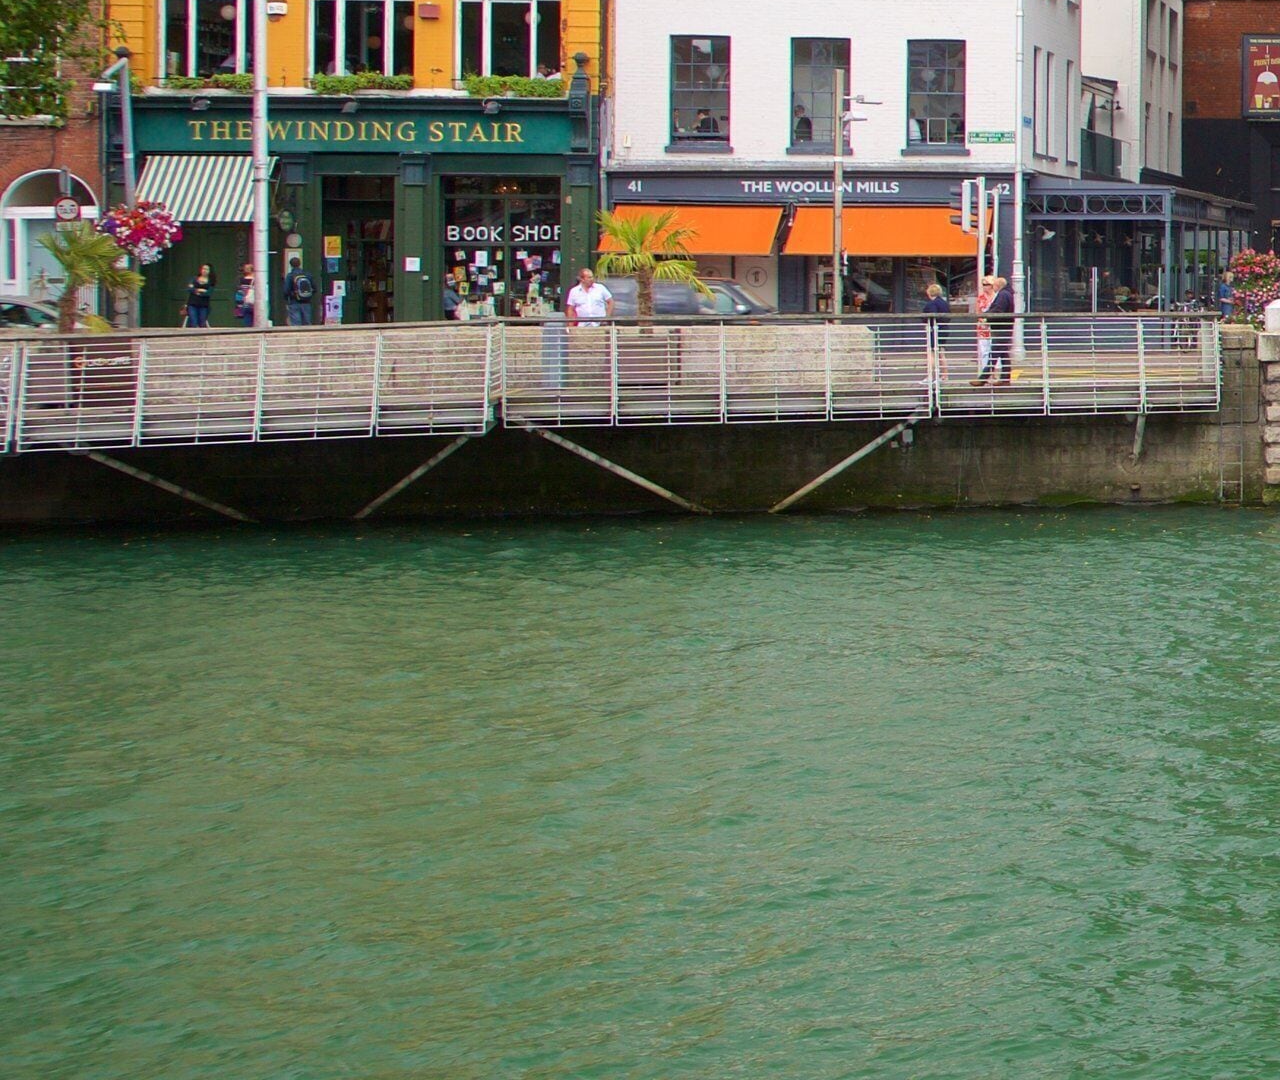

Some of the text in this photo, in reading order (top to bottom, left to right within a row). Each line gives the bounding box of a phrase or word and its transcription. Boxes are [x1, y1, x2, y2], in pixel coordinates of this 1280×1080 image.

[188, 121, 524, 143] THE WINDING STAIR
[627, 180, 642, 192] 41
[741, 180, 900, 194] THE WOOLLN MILLS
[446, 225, 504, 241] BOOK
